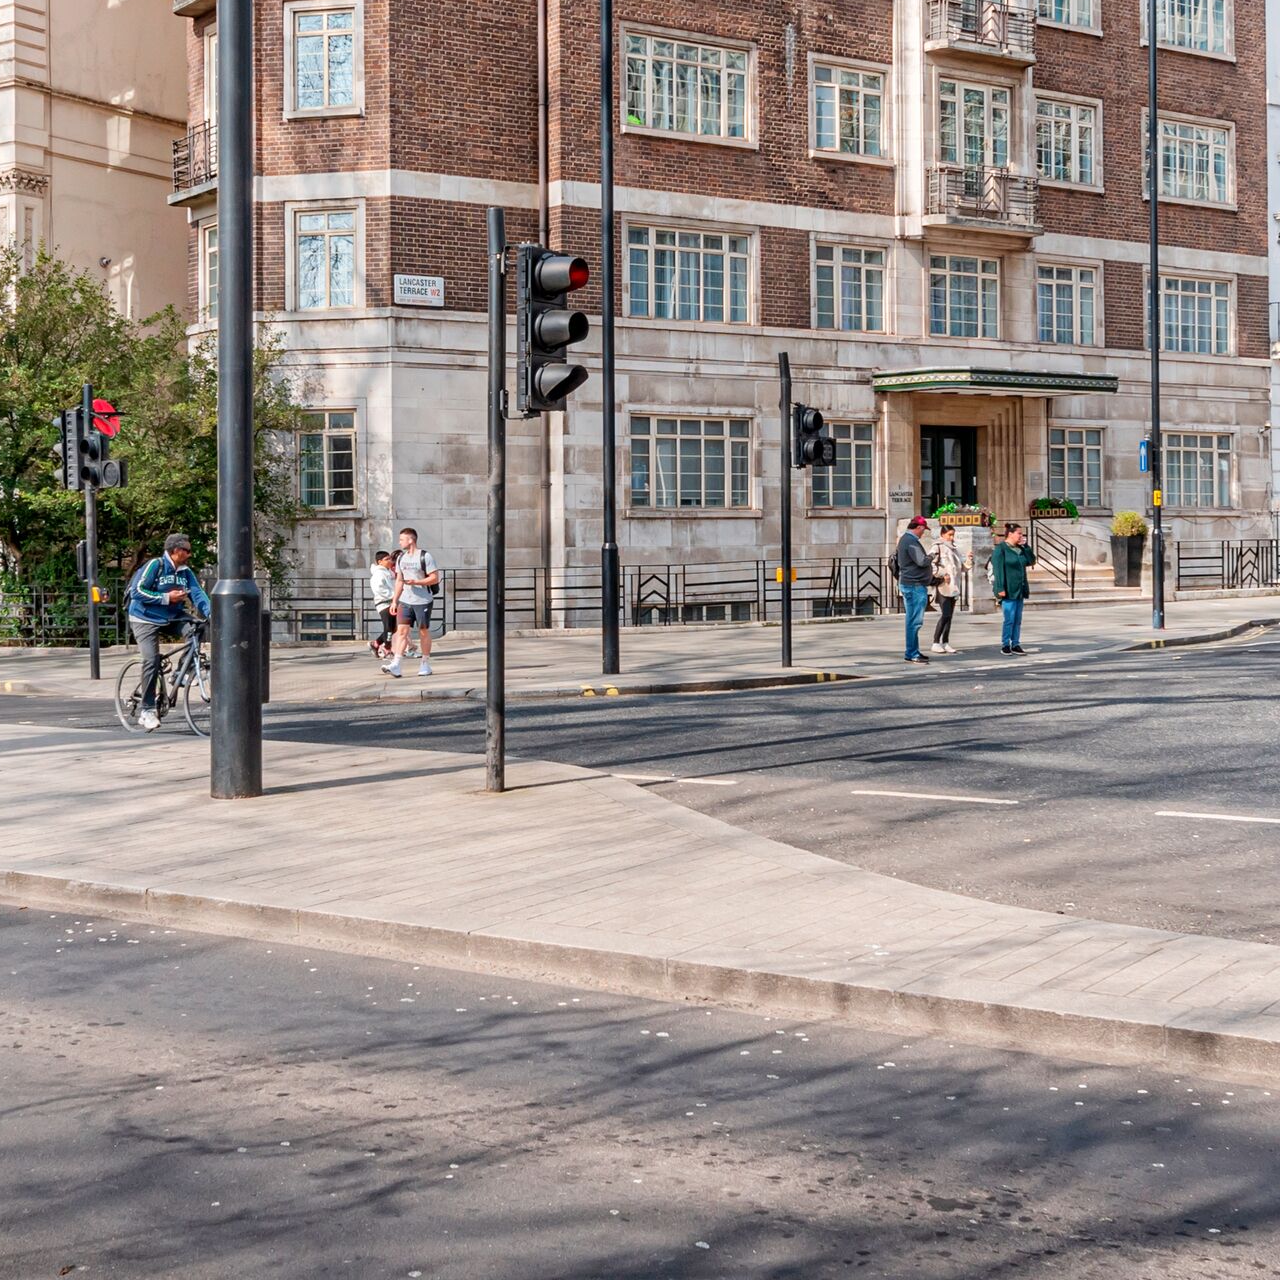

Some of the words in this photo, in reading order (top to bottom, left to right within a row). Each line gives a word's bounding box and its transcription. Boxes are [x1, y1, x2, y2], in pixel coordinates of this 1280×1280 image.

[399, 278, 437, 287] LANCASTER
[400, 287, 428, 295] TERRACE
[431, 288, 440, 297] W2
